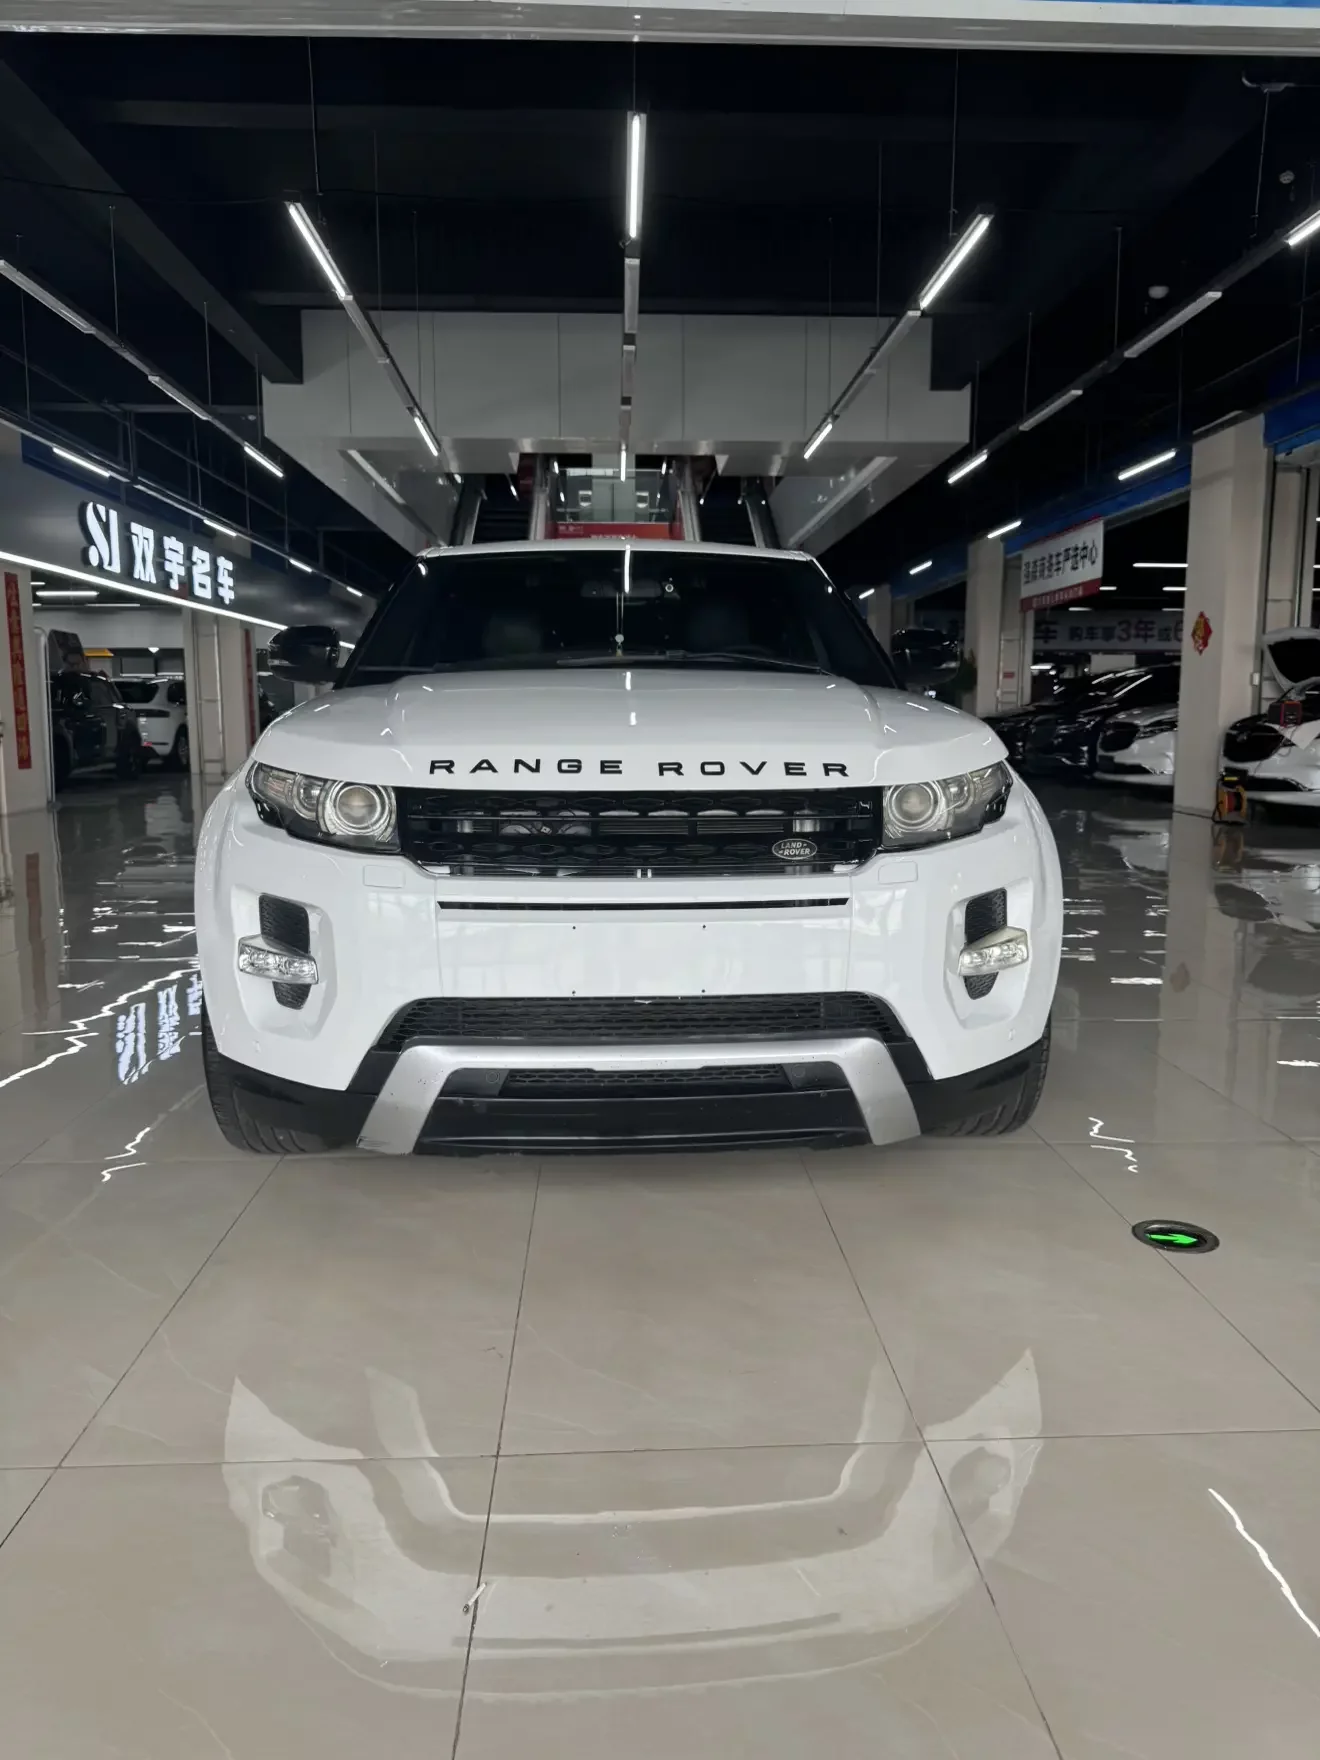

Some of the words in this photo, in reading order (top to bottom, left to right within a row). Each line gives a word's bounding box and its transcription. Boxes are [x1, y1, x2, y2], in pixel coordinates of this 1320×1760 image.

[130, 521, 235, 605] 双宇名车
[429, 758, 623, 775] RANGE
[658, 761, 850, 778] ROVER
